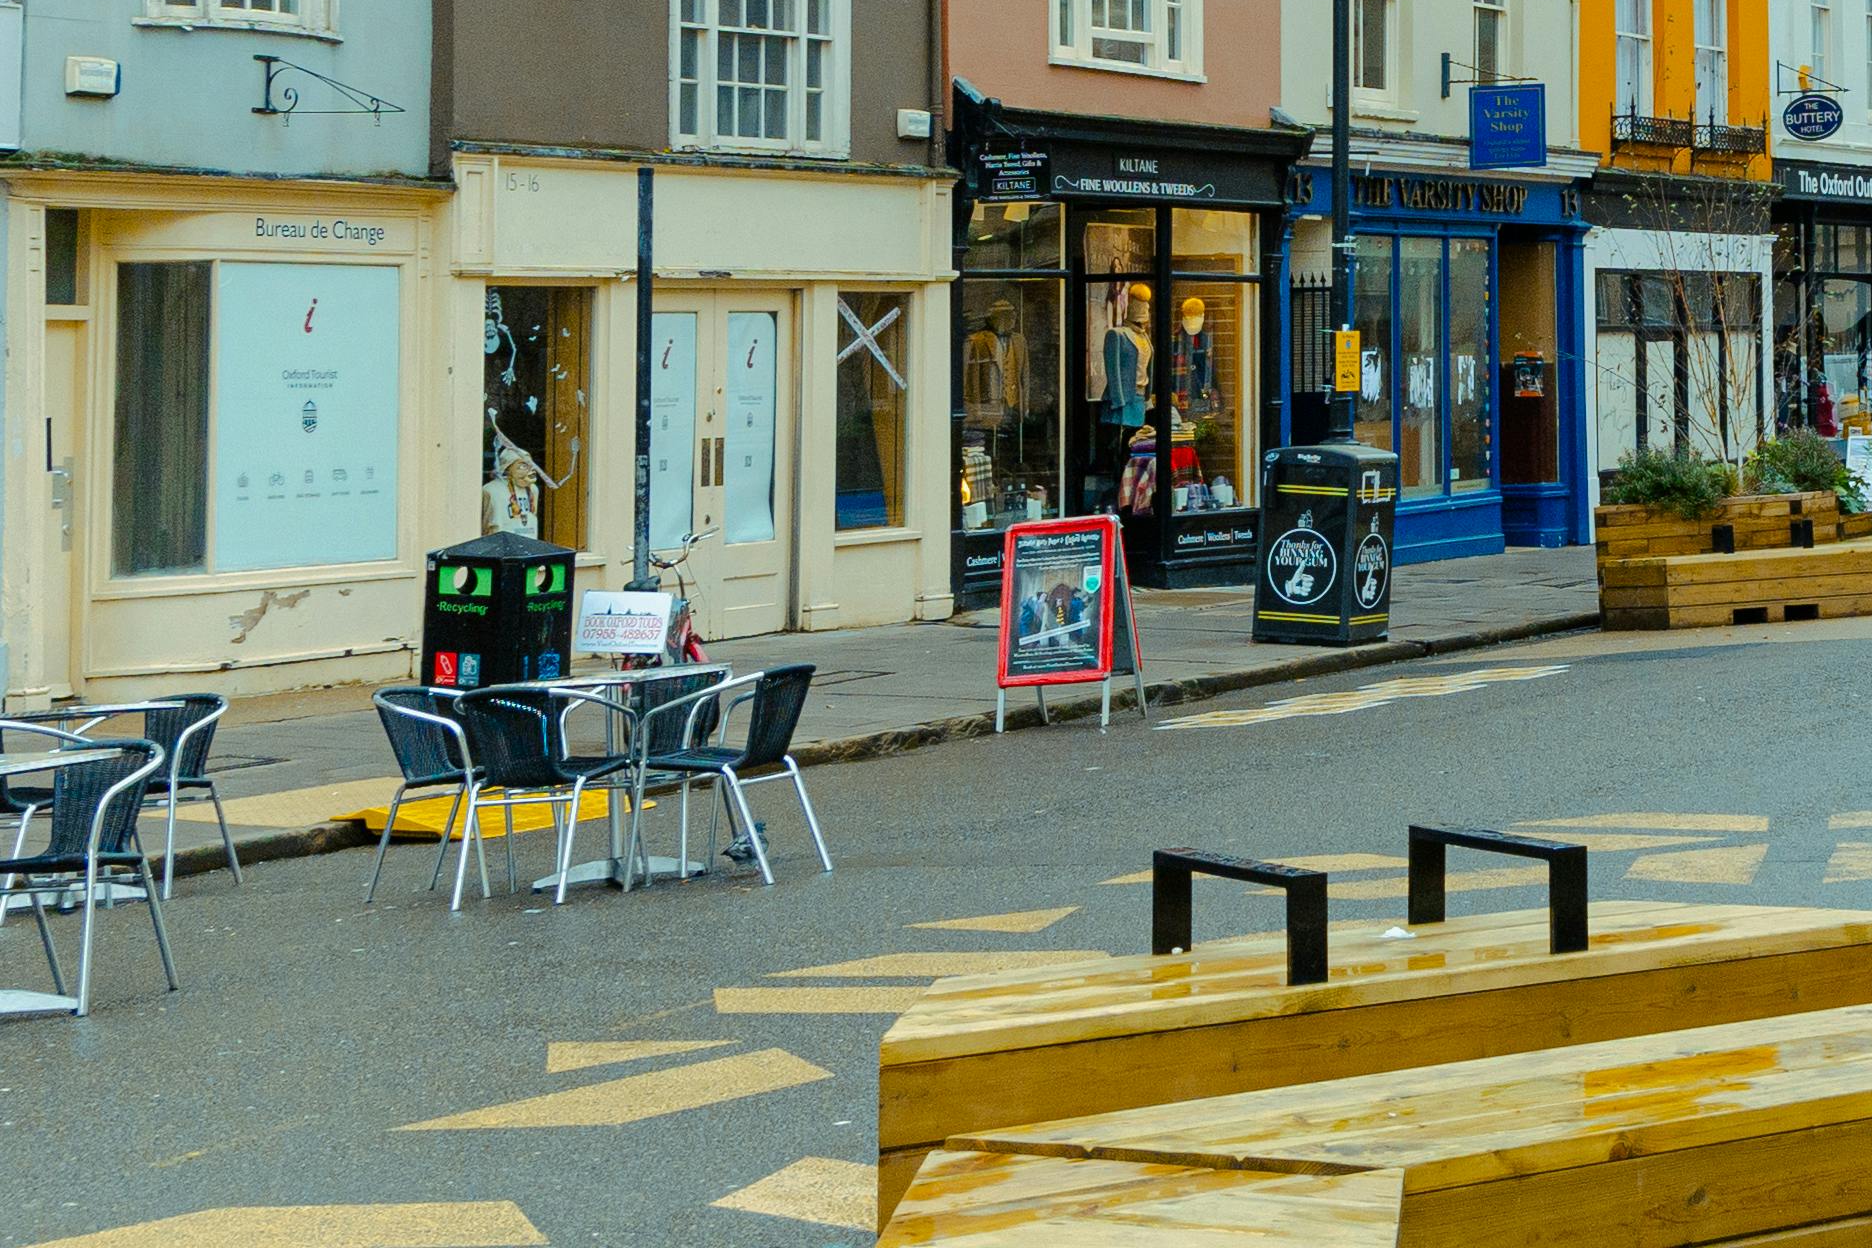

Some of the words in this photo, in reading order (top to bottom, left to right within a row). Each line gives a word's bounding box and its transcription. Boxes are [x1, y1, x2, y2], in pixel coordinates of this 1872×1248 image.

[1493, 95, 1520, 106] The
[1804, 102, 1819, 110] THE
[1482, 107, 1529, 121] Varsity
[1785, 111, 1840, 125] BUTTERY
[1490, 122, 1523, 133] Shop
[1800, 125, 1825, 133] HOTEL
[1119, 158, 1159, 174] KILTANE
[996, 180, 1031, 190] KILTANE
[1080, 178, 1101, 191] FINE
[1102, 179, 1150, 194] WOOLLENS
[1151, 182, 1159, 194] &
[1160, 183, 1195, 196] TWEEDS
[1798, 170, 1818, 194] The
[1820, 172, 1854, 197] Oxford
[1353, 176, 1394, 206] THE
[1398, 177, 1478, 211] VARSITY
[1481, 183, 1528, 213] SHOP
[1562, 189, 1579, 216] 13
[256, 217, 306, 238] Bureau
[310, 219, 328, 239] de
[333, 220, 385, 246] Change
[281, 369, 310, 381] Oxford
[311, 368, 338, 380] Tourist
[1281, 539, 1311, 550] Thanks
[1311, 540, 1324, 551] for
[1280, 548, 1324, 559] BINNING
[966, 554, 998, 567] Cashmere
[1275, 555, 1302, 566] YOUR
[1304, 556, 1328, 568] GUM
[438, 600, 487, 616] Recycling
[639, 617, 663, 629] TOURS
